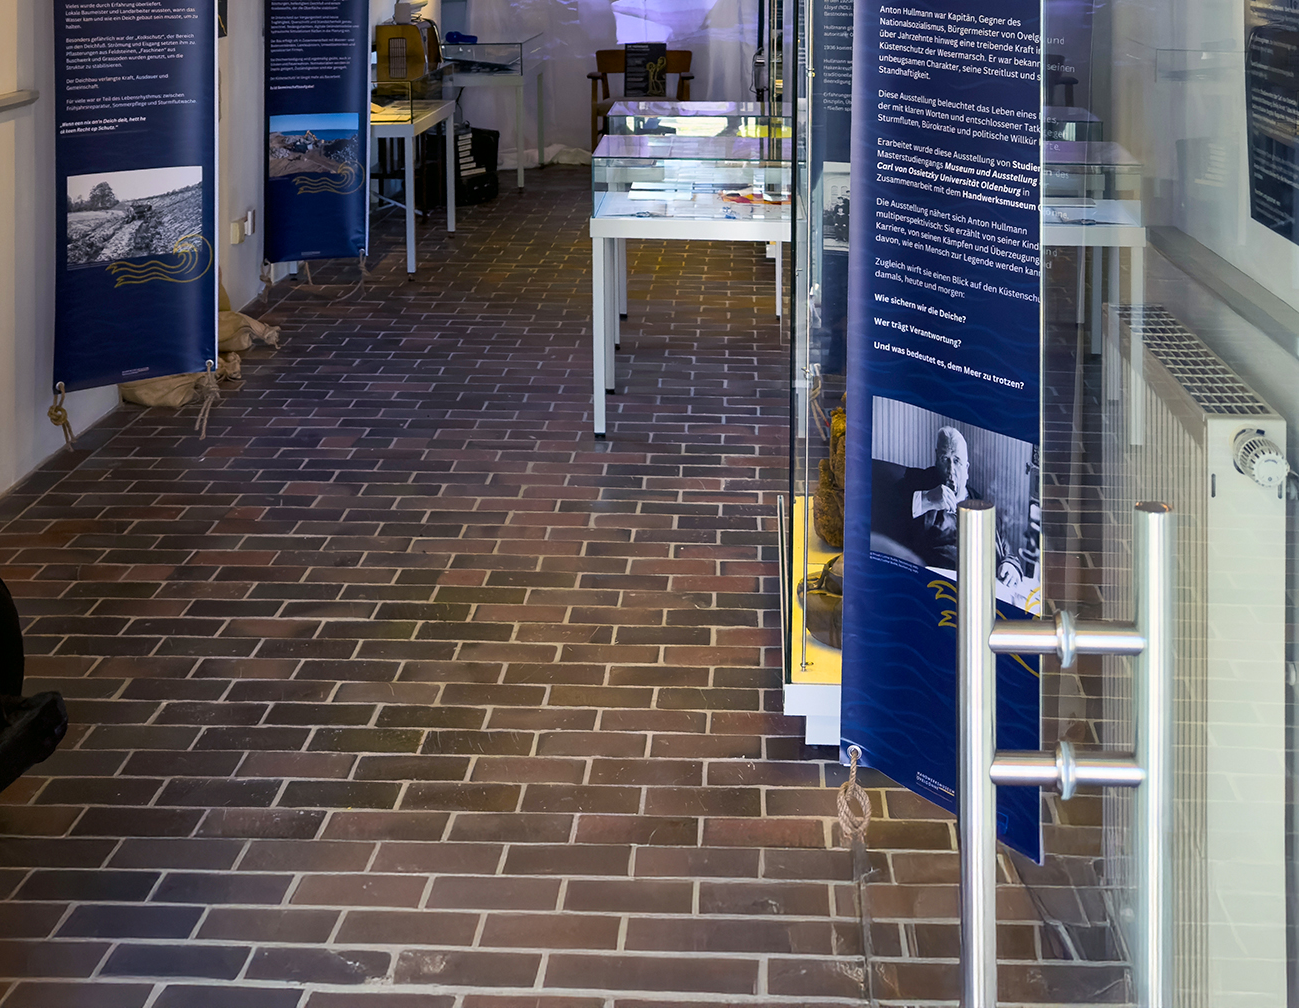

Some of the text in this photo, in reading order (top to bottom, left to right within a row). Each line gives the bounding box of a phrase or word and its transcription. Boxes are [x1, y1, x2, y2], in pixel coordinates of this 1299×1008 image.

[880, 5, 902, 14] Anton
[902, 7, 933, 17] Hullmann
[948, 12, 977, 23] Kapitän,
[978, 15, 1006, 25] Gegner
[1007, 17, 1021, 26] des
[880, 17, 946, 32] Nationalsozialismus,
[947, 24, 1000, 36] Bürgermeister
[879, 29, 1034, 53] über Jahrzehnte hinweg eine treibende Kraft
[879, 41, 924, 53] Küstenschutz
[924, 46, 936, 54] der
[937, 48, 986, 60] Wesermarsch.
[988, 53, 996, 61] Er
[879, 54, 925, 66] unbeugsamen
[926, 59, 961, 72] Charakter,
[962, 64, 982, 73] seine
[983, 66, 1018, 77] Streitlust
[879, 65, 930, 79] Standhaftigkeit.
[878, 89, 899, 99] Diese
[900, 92, 936, 107] Ausstellung
[937, 98, 975, 110] beleuchtet
[977, 103, 990, 112] das
[992, 105, 1015, 116] Leben
[1016, 109, 1037, 119] eines
[878, 101, 1023, 129] der mit klaren Worten und entschlossener
[877, 113, 920, 128] Sturmfluten,
[921, 120, 956, 132] Bürokratie
[972, 129, 1009, 140] politische
[1010, 133, 1037, 144] Willkür
[877, 138, 912, 150] Erarbeitet
[913, 145, 933, 154] wurde
[934, 147, 952, 157] diese
[953, 150, 995, 166] Ausstellung
[877, 150, 944, 170] Masterstudiengangs
[945, 162, 975, 174] Museum
[976, 169, 991, 177] und
[992, 170, 1038, 187] Ausstellung
[877, 162, 894, 171] Carl
[908, 167, 938, 181] Ossietzky
[939, 173, 979, 187] Universität
[981, 180, 1021, 196] Oldenburg
[1023, 187, 1030, 196] in
[877, 174, 1036, 210] Zusammenarbeit mit dem Handwerksmuseum
[876, 197, 1028, 234] Die Ausstellung nähert sich Anton Hullmann
[876, 211, 943, 230] multiperspektivisch:
[944, 223, 955, 232] Sie
[956, 228, 980, 237] erzählt
[997, 236, 1020, 245] seiner
[876, 221, 907, 236] Karriere,
[921, 232, 941, 242] seinen
[943, 236, 973, 249] Kämpfen
[876, 233, 901, 247] davon,
[902, 240, 913, 248] wie
[914, 242, 924, 250] ein
[925, 244, 950, 256] Mensch
[963, 252, 994, 265] Legende
[995, 261, 1023, 272] werden
[875, 257, 906, 271] Zugleich
[907, 265, 922, 275] wirft
[923, 269, 932, 277] sie
[933, 271, 951, 281] einen
[952, 275, 968, 285] Blick
[983, 282, 997, 292] den
[875, 269, 903, 284] damals,
[905, 276, 923, 287] heute
[938, 286, 965, 297] morgen:
[874, 293, 966, 323] Wie sichern wir die Deiche?
[874, 317, 962, 348] Wer trägt Verantwortung?
[874, 342, 890, 352] Und
[906, 350, 936, 365] bedeutet
[937, 361, 947, 370] es,
[947, 362, 963, 372] dem
[964, 366, 982, 377] Meer
[993, 375, 1024, 389] trotzen?
